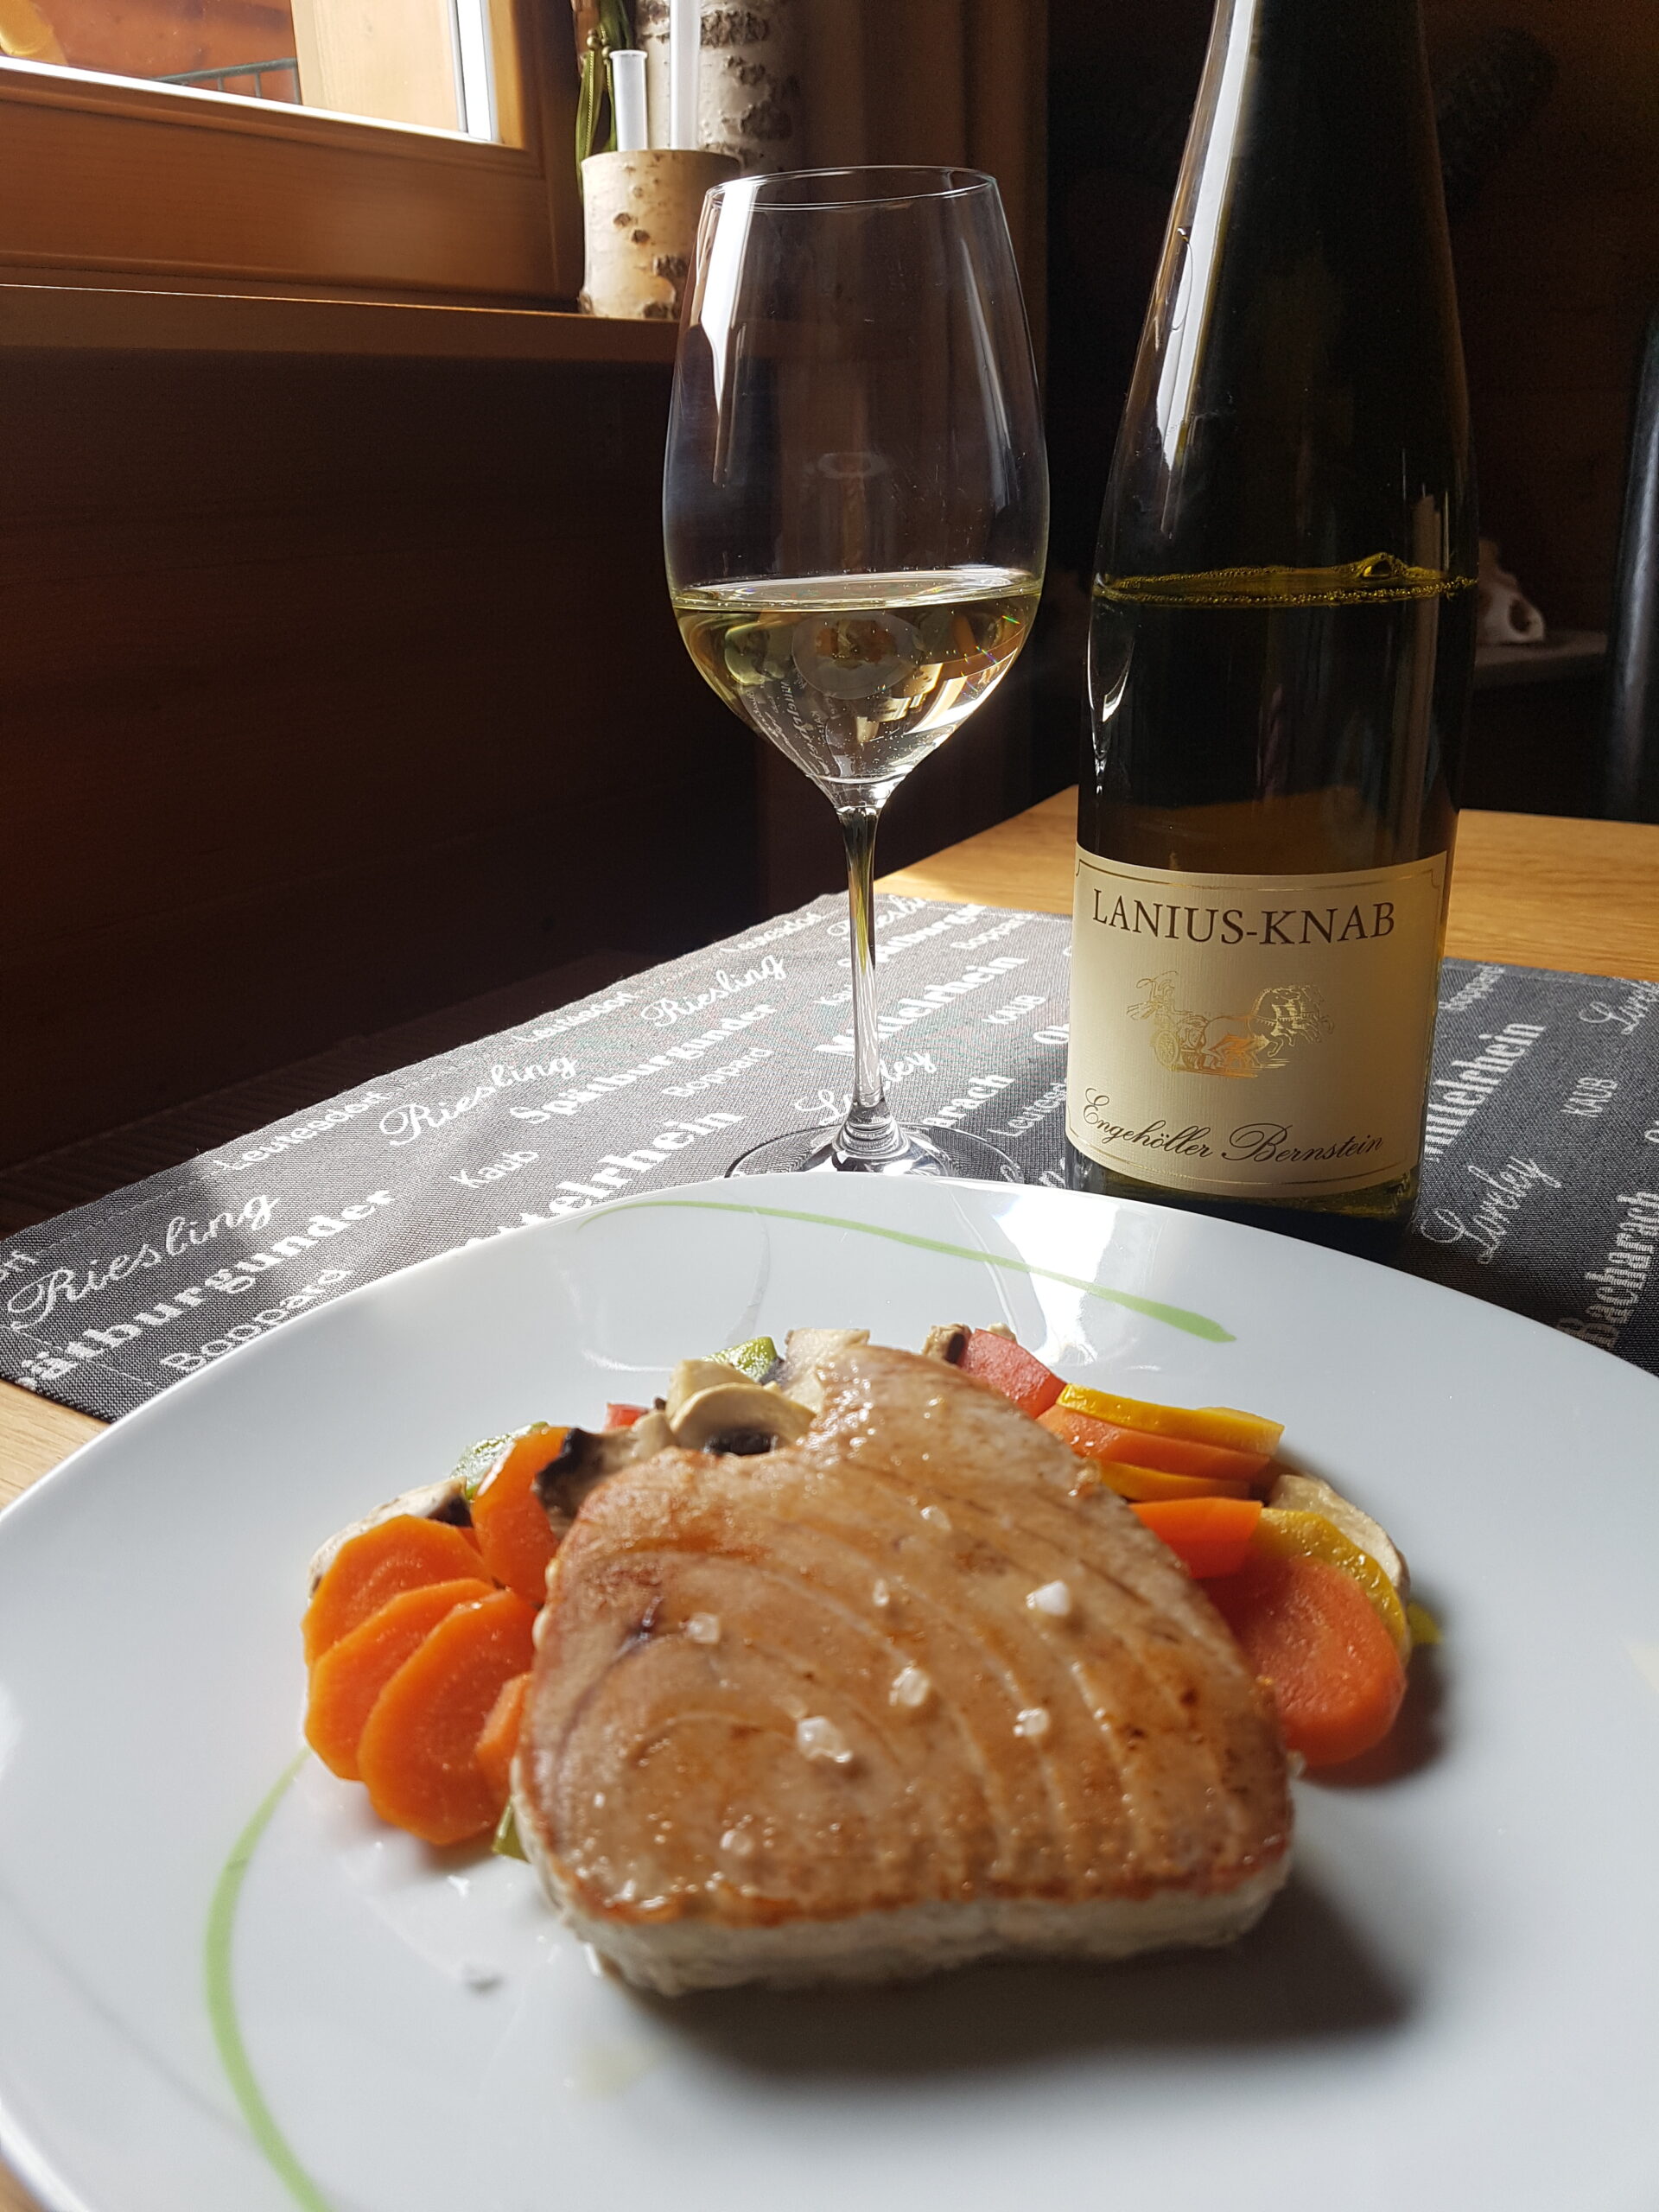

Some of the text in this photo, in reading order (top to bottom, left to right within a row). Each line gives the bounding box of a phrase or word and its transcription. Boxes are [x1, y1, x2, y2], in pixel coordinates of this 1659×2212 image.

[1092, 887, 1395, 946] LANIUS-KNAB
[640, 954, 787, 1027] Riesling
[378, 1058, 578, 1146] Riesling
[1083, 1087, 1384, 1163] Engehöller Bernstein
[1559, 1077, 1618, 1118] KAUB
[449, 1150, 540, 1189] Kaub
[7, 1194, 280, 1331] Riesling
